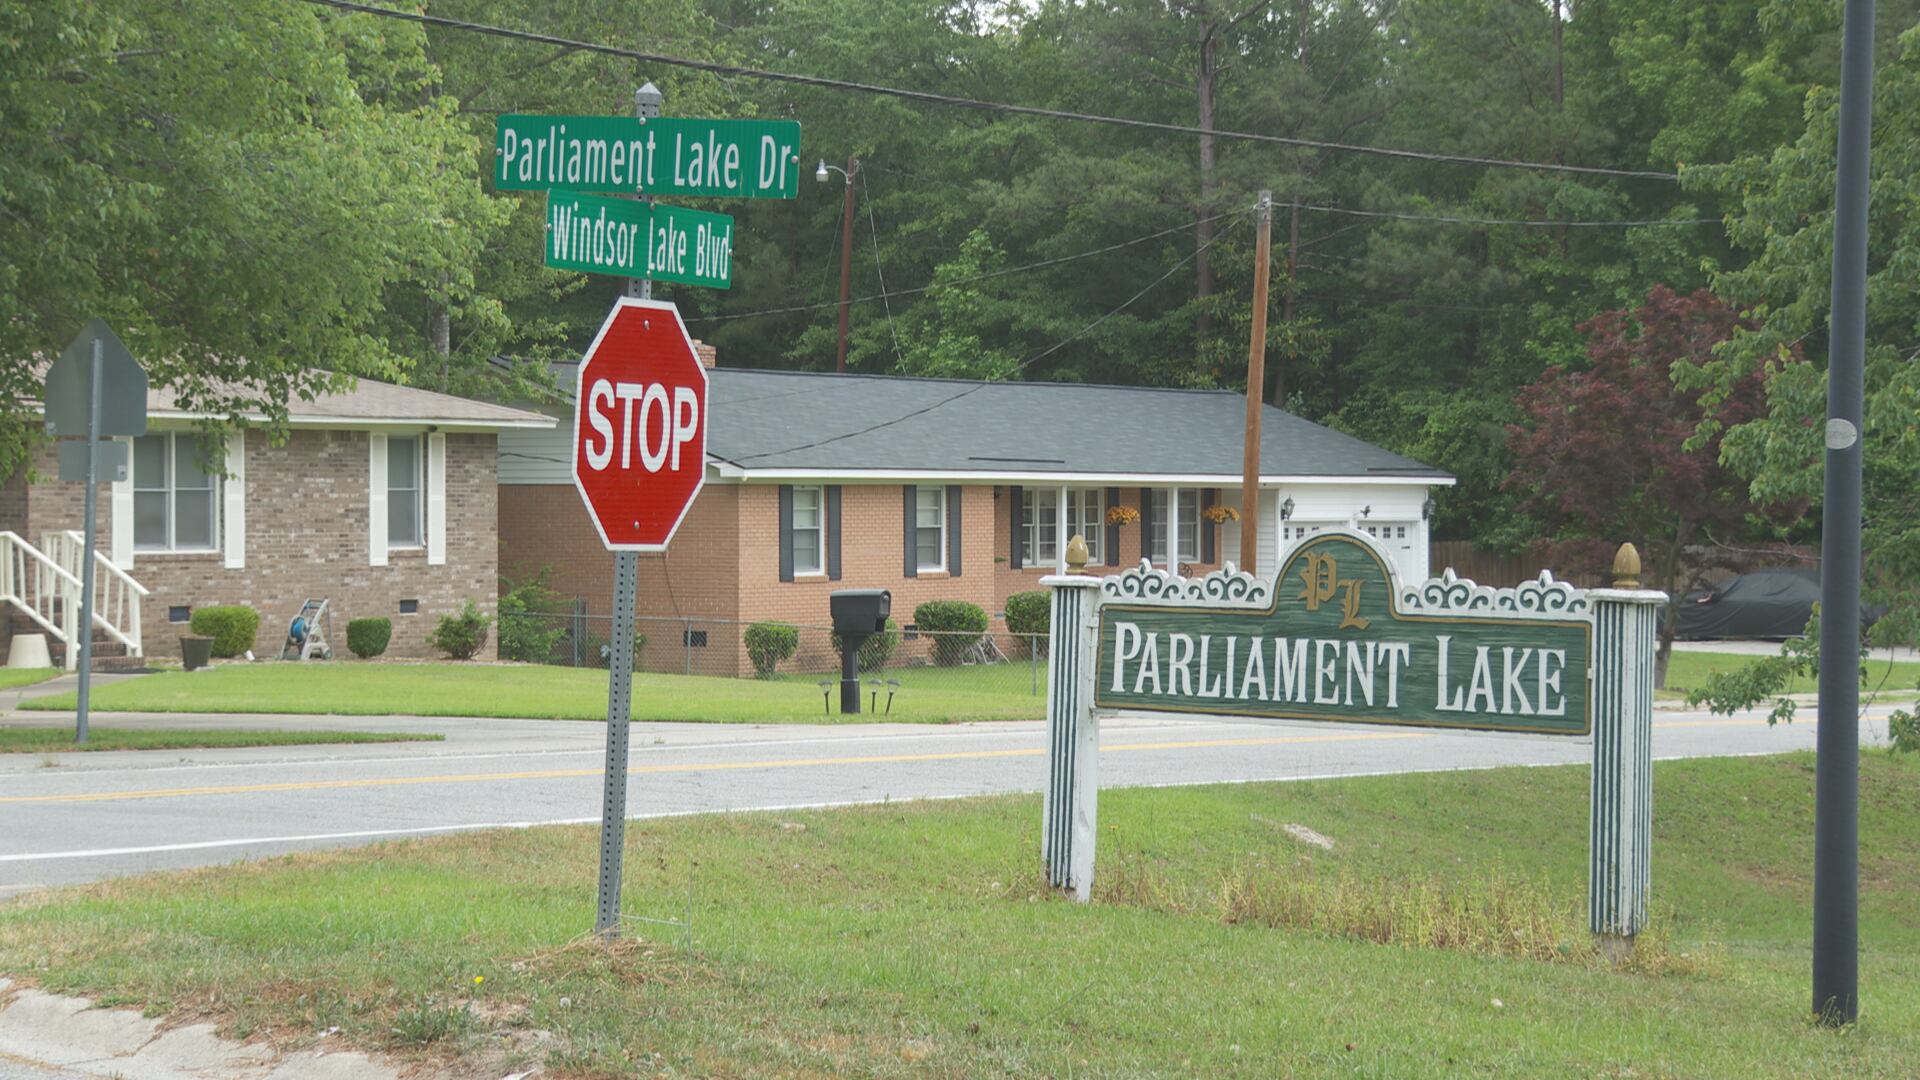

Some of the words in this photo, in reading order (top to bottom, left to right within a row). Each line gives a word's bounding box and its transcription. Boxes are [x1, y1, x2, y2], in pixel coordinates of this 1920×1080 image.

[502, 124, 656, 185] Parliament
[674, 129, 739, 188] Lake
[758, 135, 791, 190] Dr
[553, 201, 638, 268] Windsor
[647, 216, 687, 275] Lake
[695, 222, 730, 281] Blvd
[585, 378, 699, 473] STOP
[1109, 621, 1410, 708] PARLIAMENT
[1434, 635, 1567, 716] LAKE
